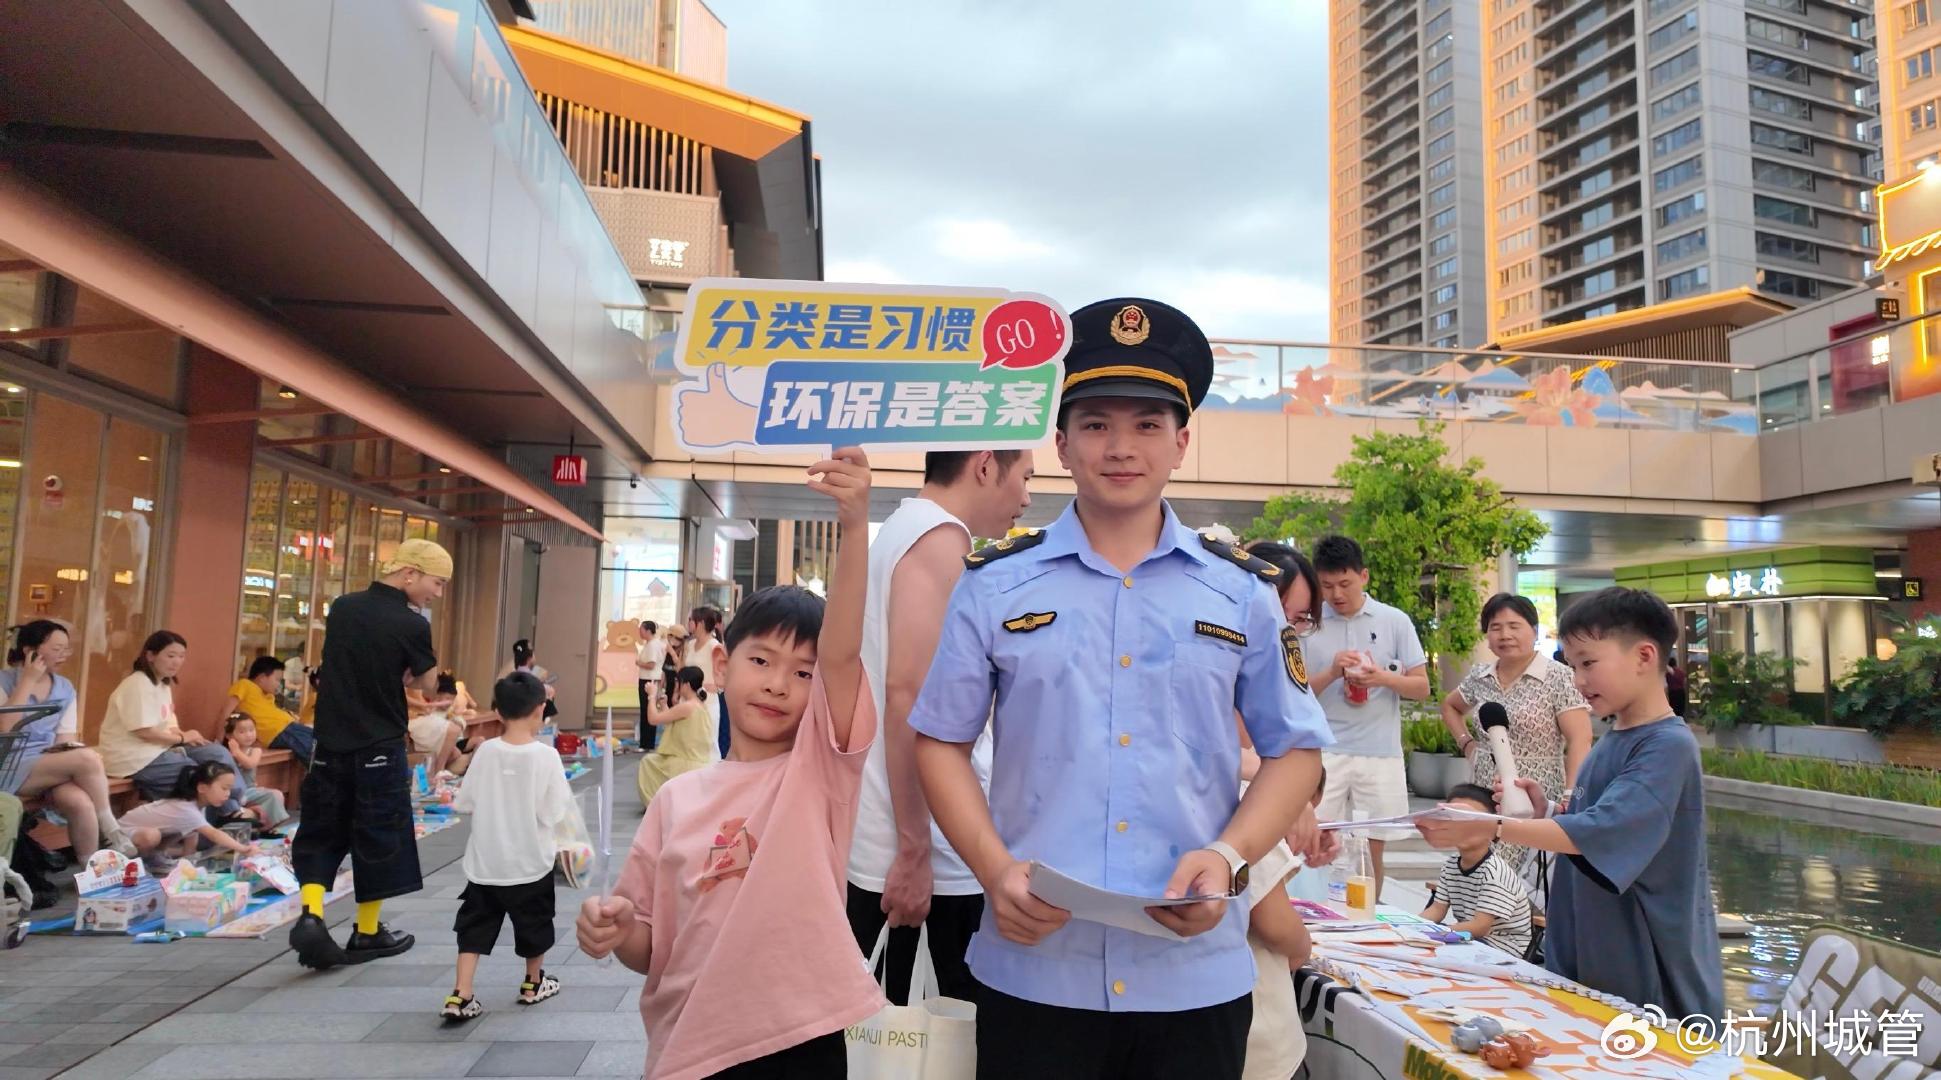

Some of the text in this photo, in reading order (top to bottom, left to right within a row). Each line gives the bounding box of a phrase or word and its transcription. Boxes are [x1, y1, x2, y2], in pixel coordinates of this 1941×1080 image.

[705, 299, 977, 352] 分类是习惯
[763, 380, 1050, 430] 环保是答案
